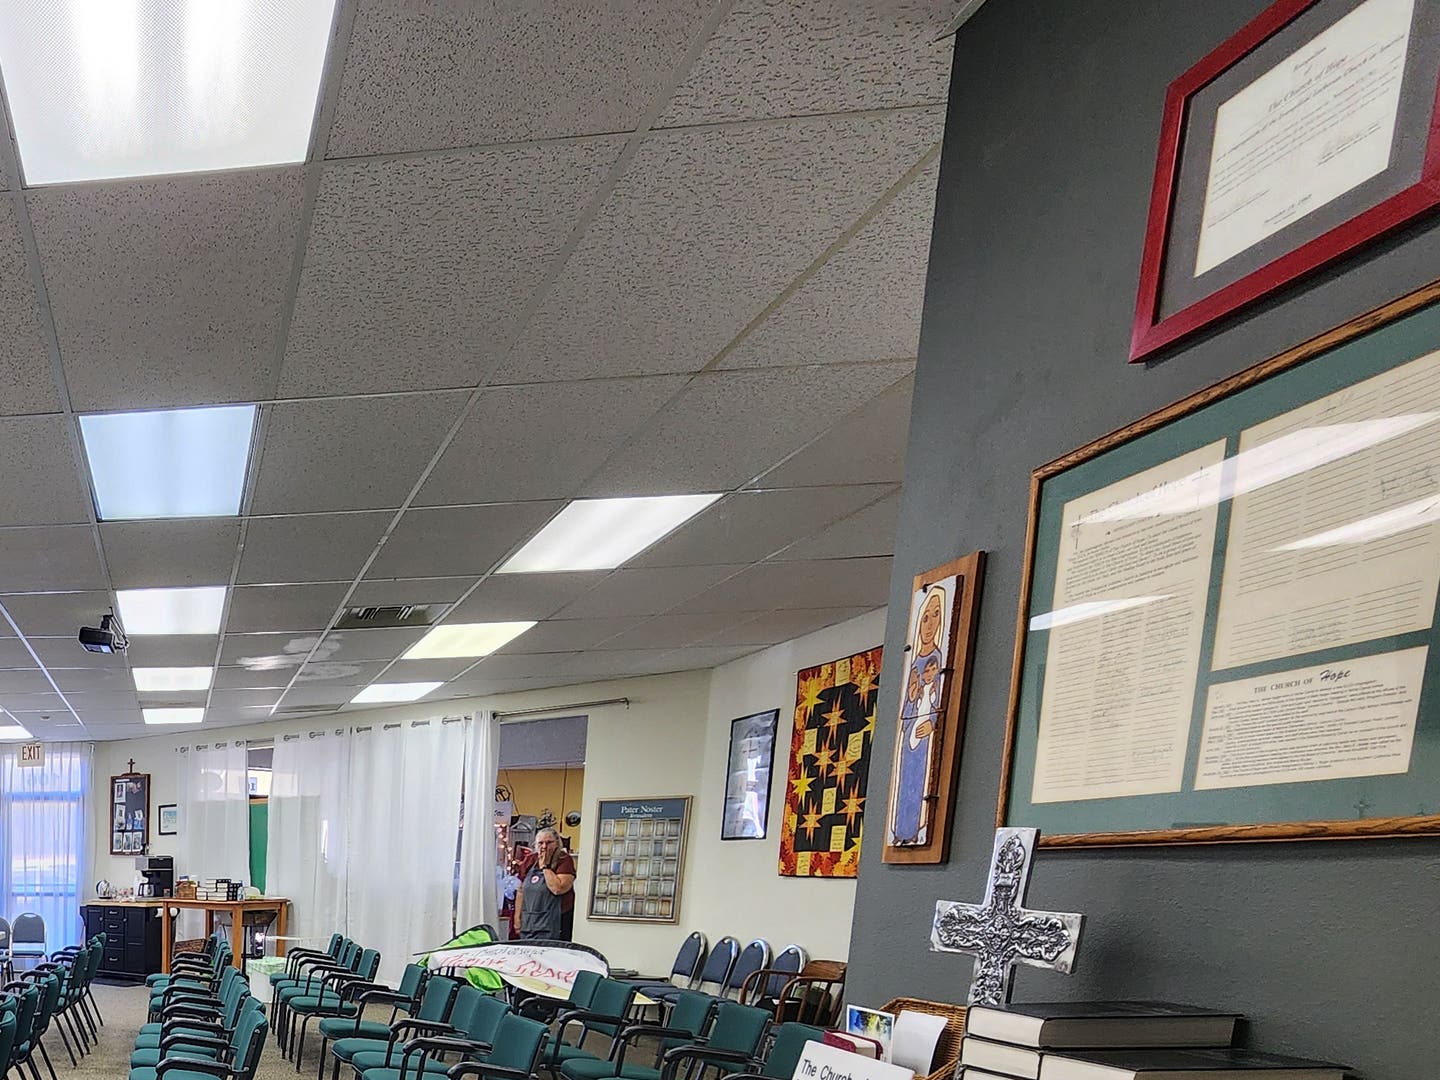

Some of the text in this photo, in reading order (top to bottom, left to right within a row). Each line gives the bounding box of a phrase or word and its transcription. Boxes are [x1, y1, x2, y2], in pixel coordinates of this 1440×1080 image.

[1270, 680, 1301, 691] CHURCH
[1303, 677, 1314, 685] OF
[1320, 669, 1351, 682] Hope
[22, 745, 41, 761] EXIT
[640, 804, 663, 814] Noster
[801, 1058, 817, 1077] The
